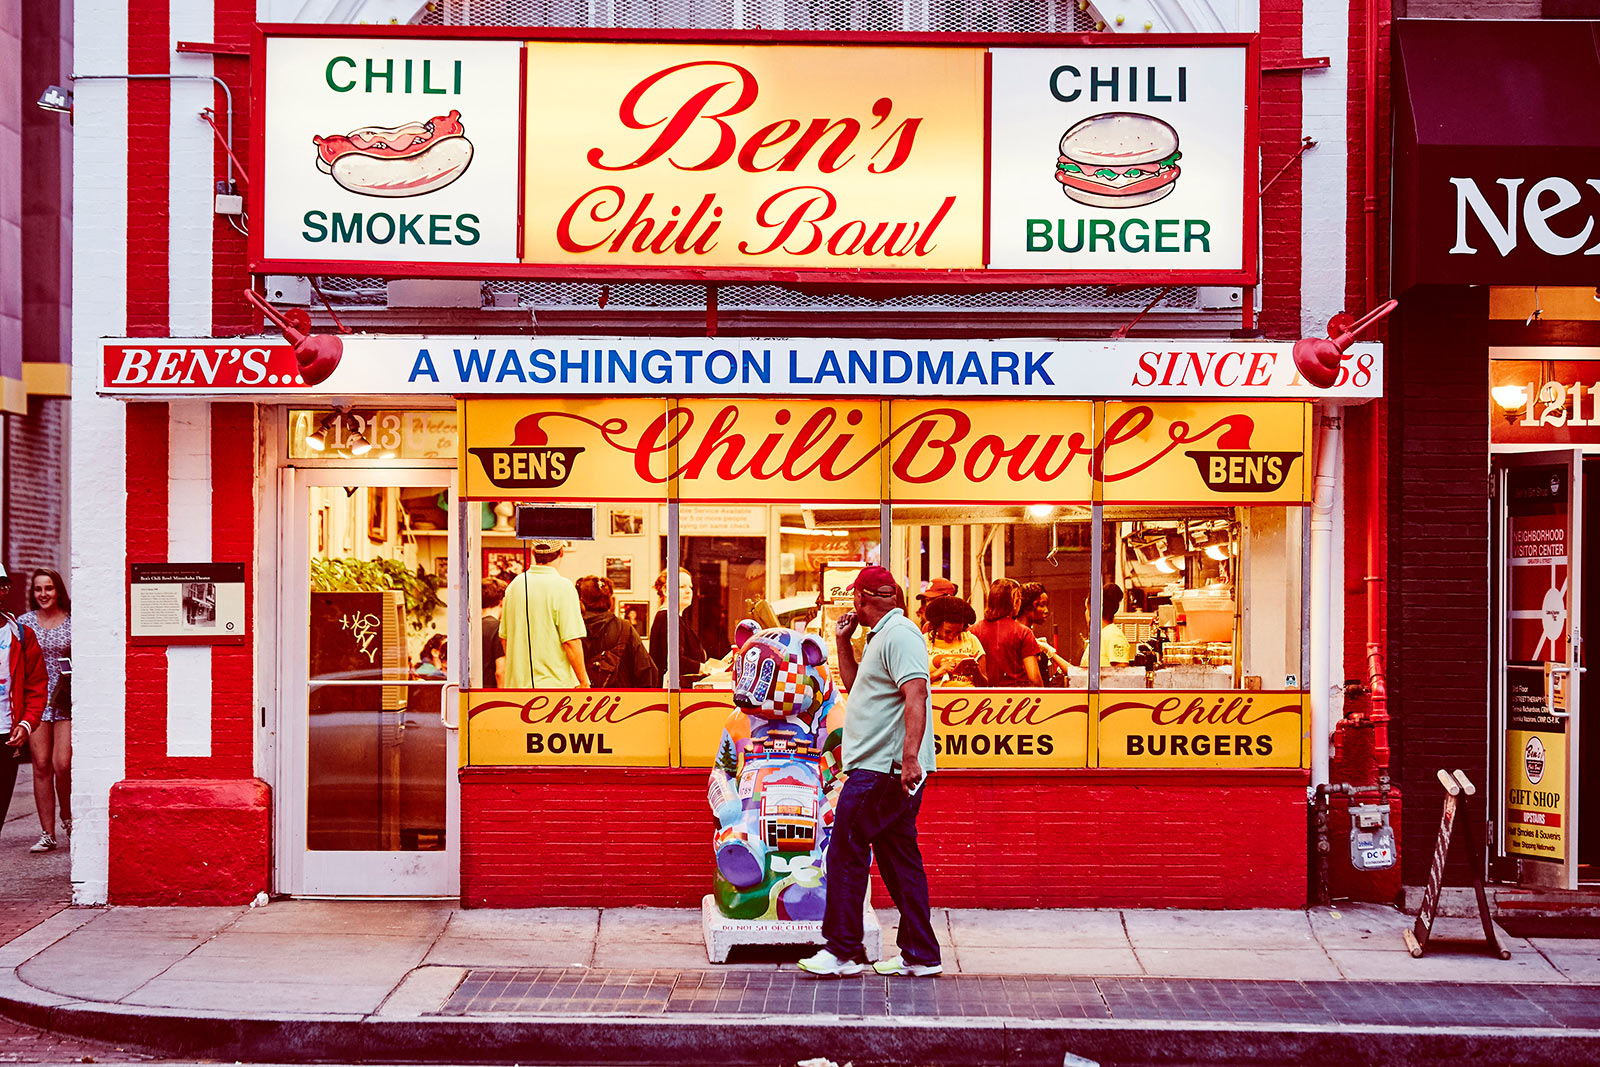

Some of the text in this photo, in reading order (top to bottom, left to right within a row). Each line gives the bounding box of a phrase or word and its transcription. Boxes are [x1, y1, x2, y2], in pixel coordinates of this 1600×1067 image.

[325, 55, 463, 95] CHILI
[1049, 65, 1187, 103] CHILI
[587, 60, 924, 174] Ben's
[302, 211, 481, 246] SMOKES
[556, 185, 957, 257] Chili Bowl
[1449, 176, 1600, 257] Ne
[1026, 218, 1211, 254] BURGER
[408, 349, 1055, 386] A WASHINGTON LANDMARK
[1131, 351, 1278, 388] SINCE
[634, 403, 1156, 485] Chili Bowl
[492, 452, 566, 481] BEN'S
[1209, 454, 1283, 485] BEN'S
[1538, 543, 1564, 556] CENTER
[520, 695, 622, 724] Chili
[941, 697, 1043, 726] Chili
[1152, 697, 1262, 726] Chili
[526, 732, 613, 754] BOWL
[1126, 734, 1273, 756] BURGERS
[1509, 788, 1560, 809] GIFT SHOP
[1523, 811, 1546, 825] UPSTAIRS
